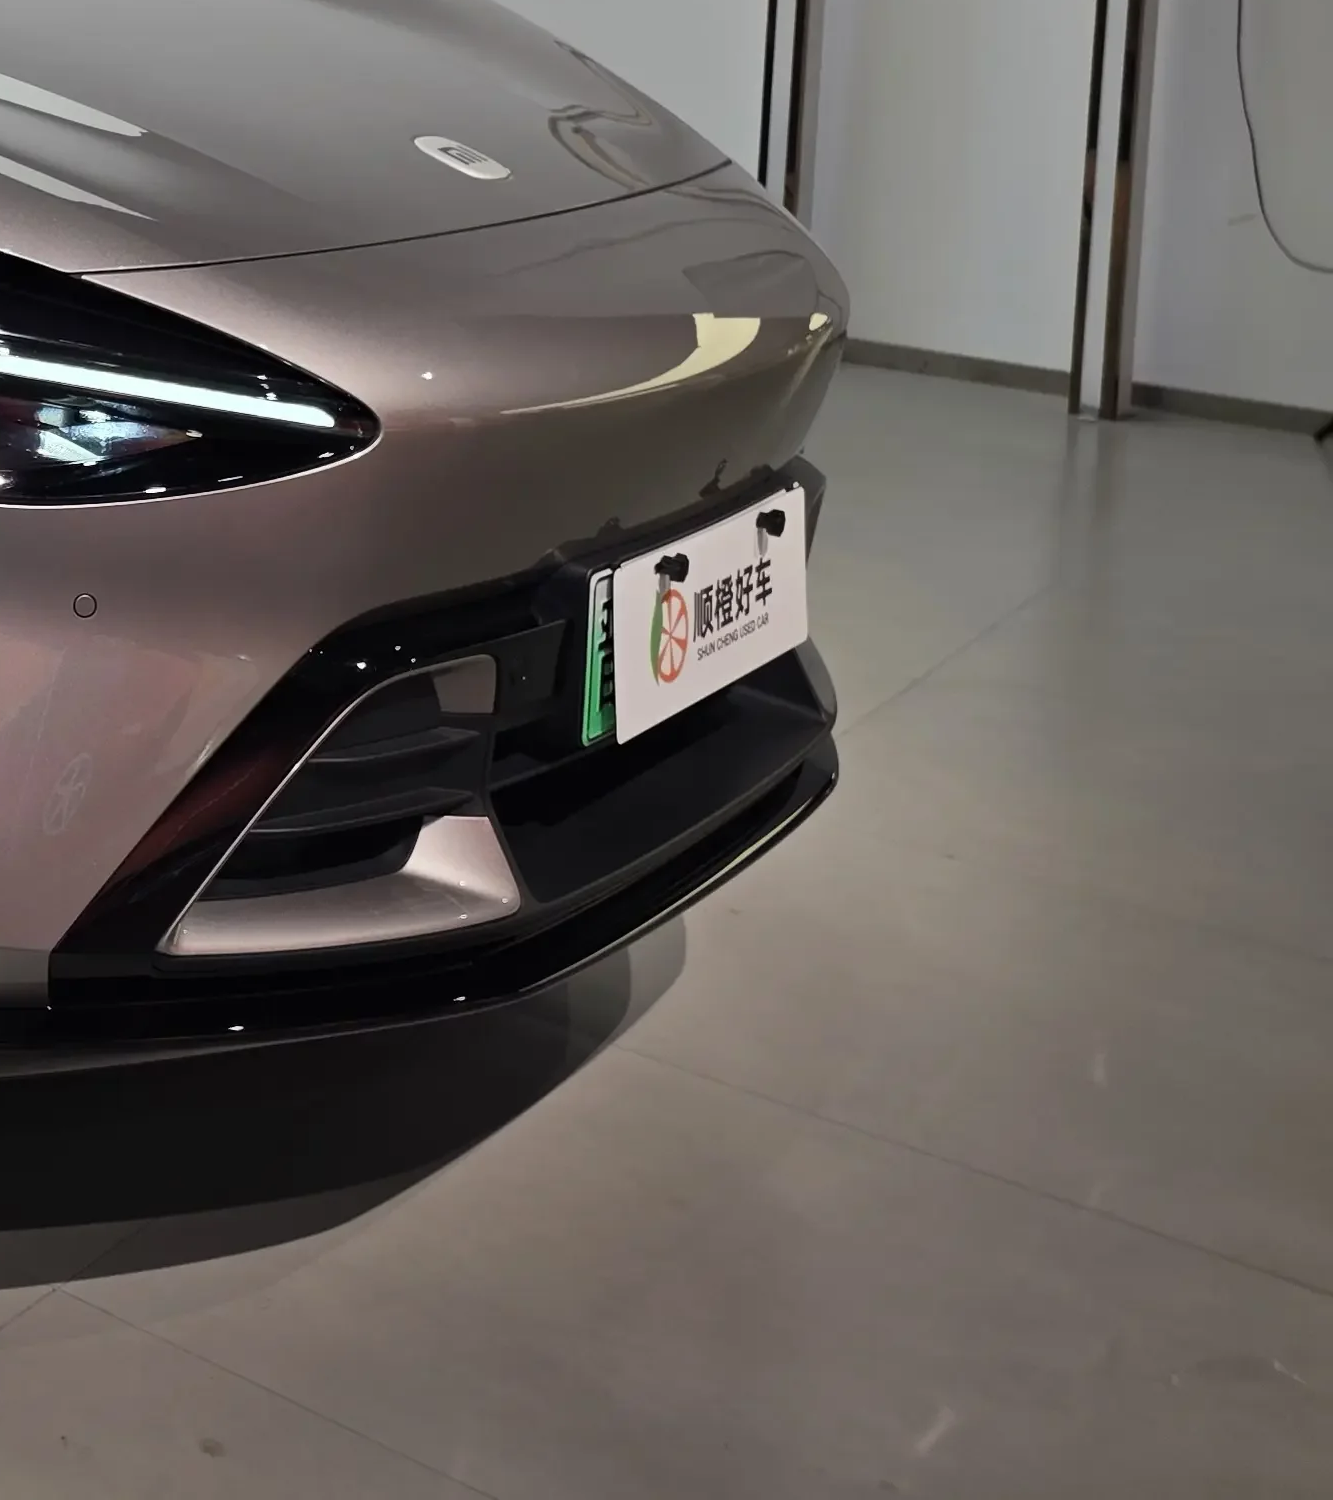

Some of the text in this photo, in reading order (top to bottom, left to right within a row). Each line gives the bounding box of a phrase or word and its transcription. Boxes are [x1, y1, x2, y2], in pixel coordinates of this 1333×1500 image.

[693, 557, 772, 642] 顺橙好车
[697, 642, 715, 661] SHUN
[716, 629, 738, 651] CHENG
[757, 611, 769, 629] CAR
